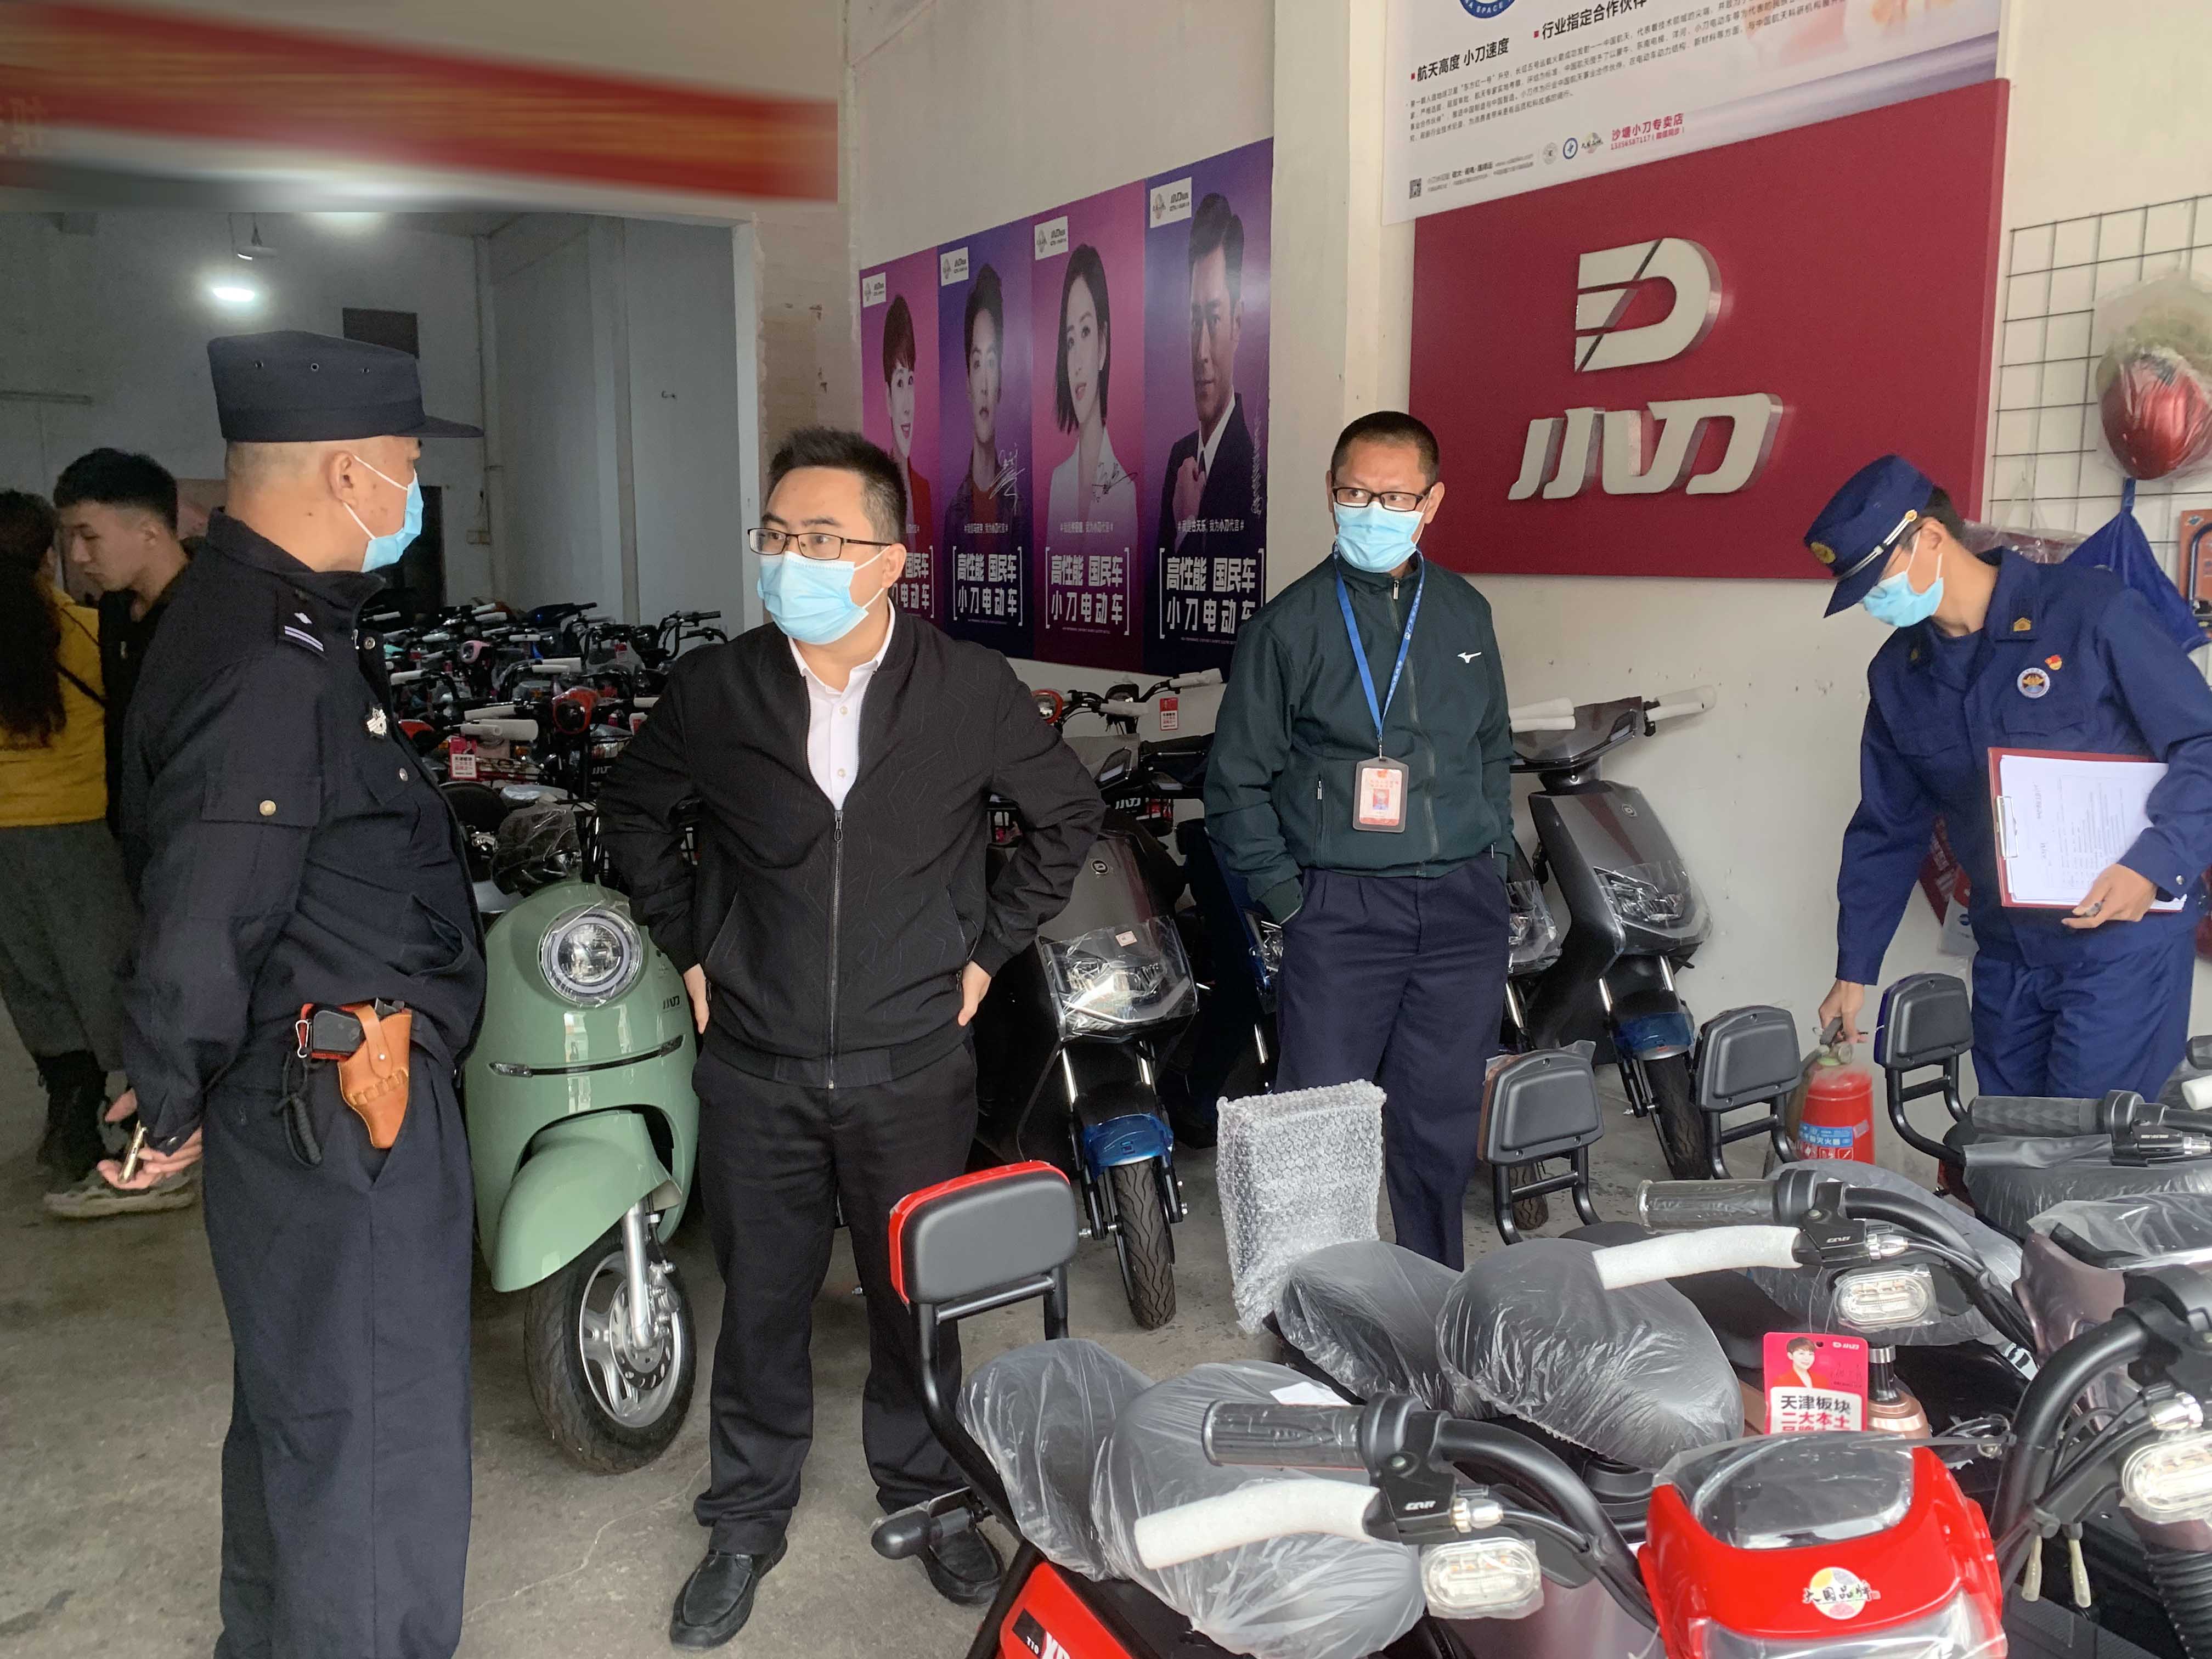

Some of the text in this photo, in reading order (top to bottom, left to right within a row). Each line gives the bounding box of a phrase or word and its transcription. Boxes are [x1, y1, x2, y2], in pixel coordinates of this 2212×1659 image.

[1417, 37, 1509, 82] 航天高度 小刀速度
[1611, 112, 1684, 141] 沙塘小刀专卖店
[906, 552, 929, 579] 国民车
[957, 553, 1017, 583] 高性能 国民车
[1051, 555, 1123, 588] 高性能 国民车
[1166, 557, 1256, 593] 高性能 国民车
[958, 585, 1017, 617] 小刀电动车
[1051, 590, 1123, 625] 小刀电动车
[1781, 1395, 1850, 1415] 天津板块
